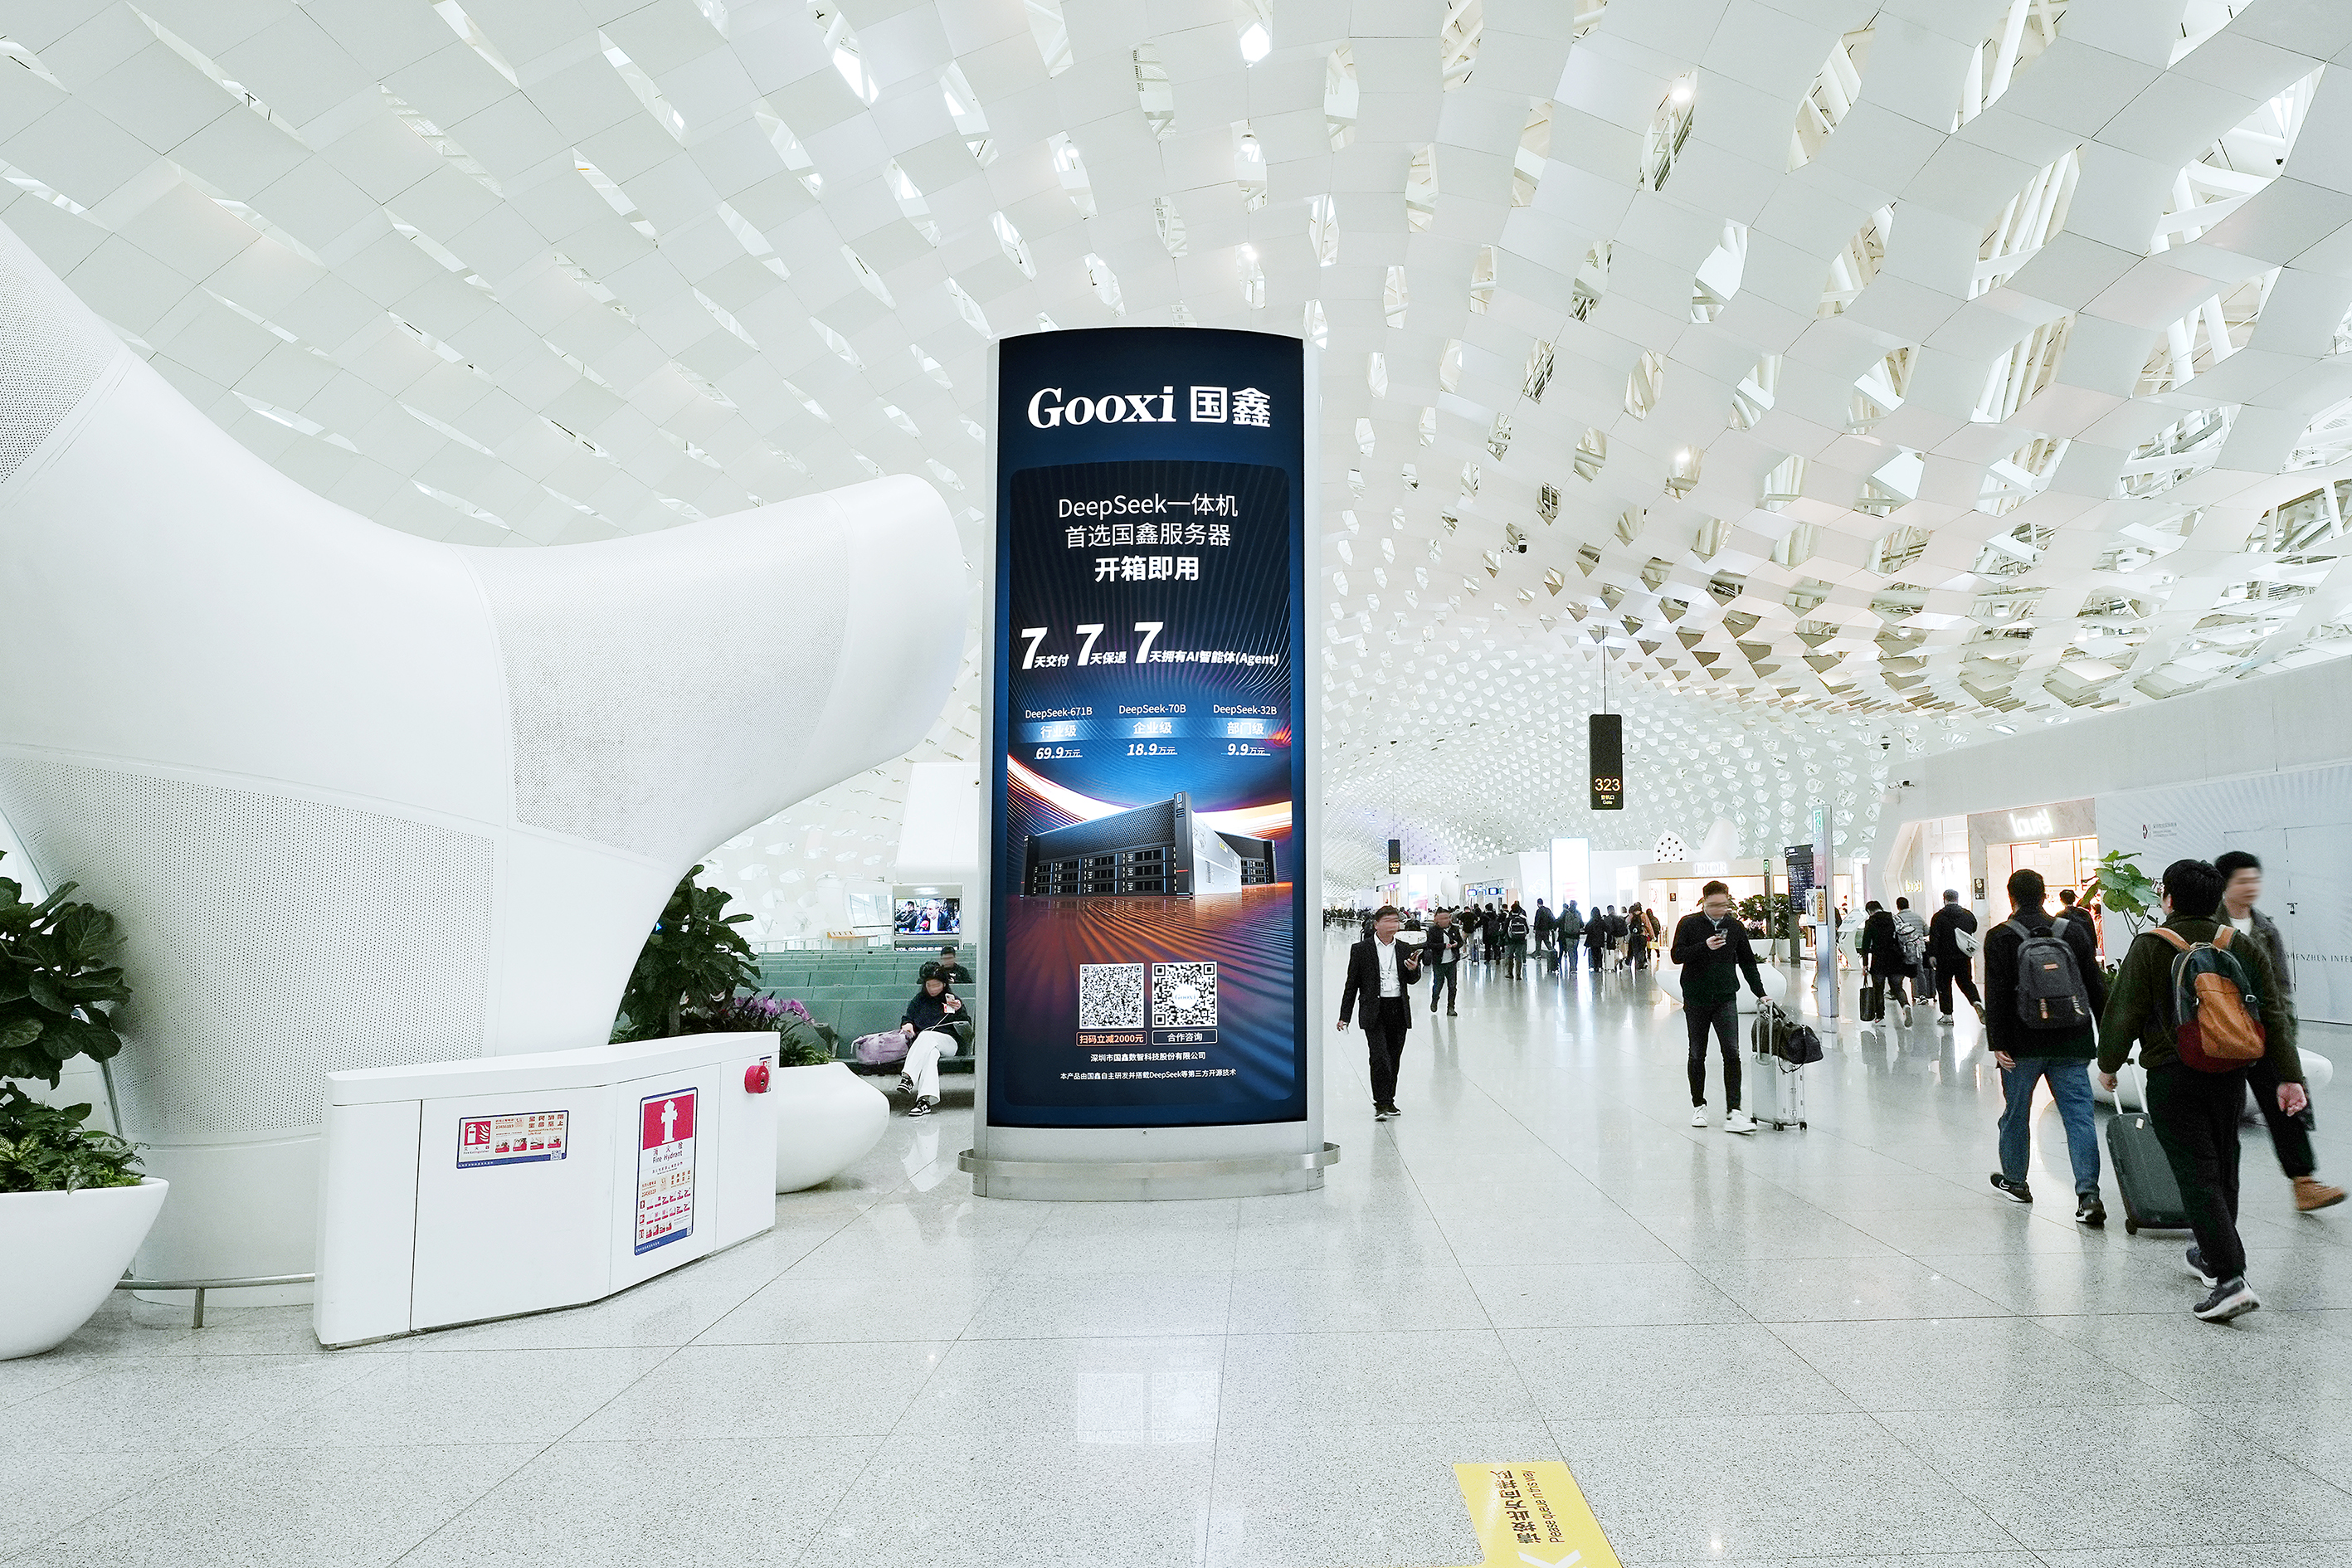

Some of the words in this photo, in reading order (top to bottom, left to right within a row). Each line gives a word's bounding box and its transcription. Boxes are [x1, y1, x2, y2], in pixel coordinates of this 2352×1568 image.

[1028, 385, 1176, 429] Gooxi
[1190, 386, 1271, 427] 国鑫
[1059, 493, 1238, 519] DeepSeek一体机
[1065, 522, 1231, 548] 首选国鑫服务器
[1095, 555, 1199, 582] 开箱即用
[1021, 627, 1070, 670] 7天交付
[1076, 623, 1127, 666] 7天保退
[1134, 621, 1279, 666] 7天拥有AI智能体(Agent)
[1025, 707, 1093, 719] DeepSeek-671B
[1119, 704, 1186, 716] DeepSeek-70B
[1213, 705, 1277, 716] DeepSeek-32B
[1040, 725, 1077, 739] 行业级
[1133, 721, 1172, 735] 企业级
[1227, 721, 1264, 735] 部门级
[1036, 746, 1081, 760] 69.9万元
[1127, 743, 1176, 756] 18.9万元
[1227, 743, 1265, 756] 9.9万元
[1595, 778, 1620, 791] 323
[1695, 862, 1727, 875] DIOR
[1079, 1034, 1144, 1044] 扫码立减2000元
[1167, 1032, 1203, 1042] 合作咨询
[1091, 1052, 1206, 1062] 深圳市国鑫数智科技股份有限公司
[663, 1150, 682, 1161] Hydrant
[1521, 1470, 1536, 1482] way
[1525, 1482, 1541, 1493] this
[1490, 1470, 1541, 1544] 请按此方向排队
[1535, 1500, 1556, 1520] queue
[1545, 1520, 1565, 1543] Please
